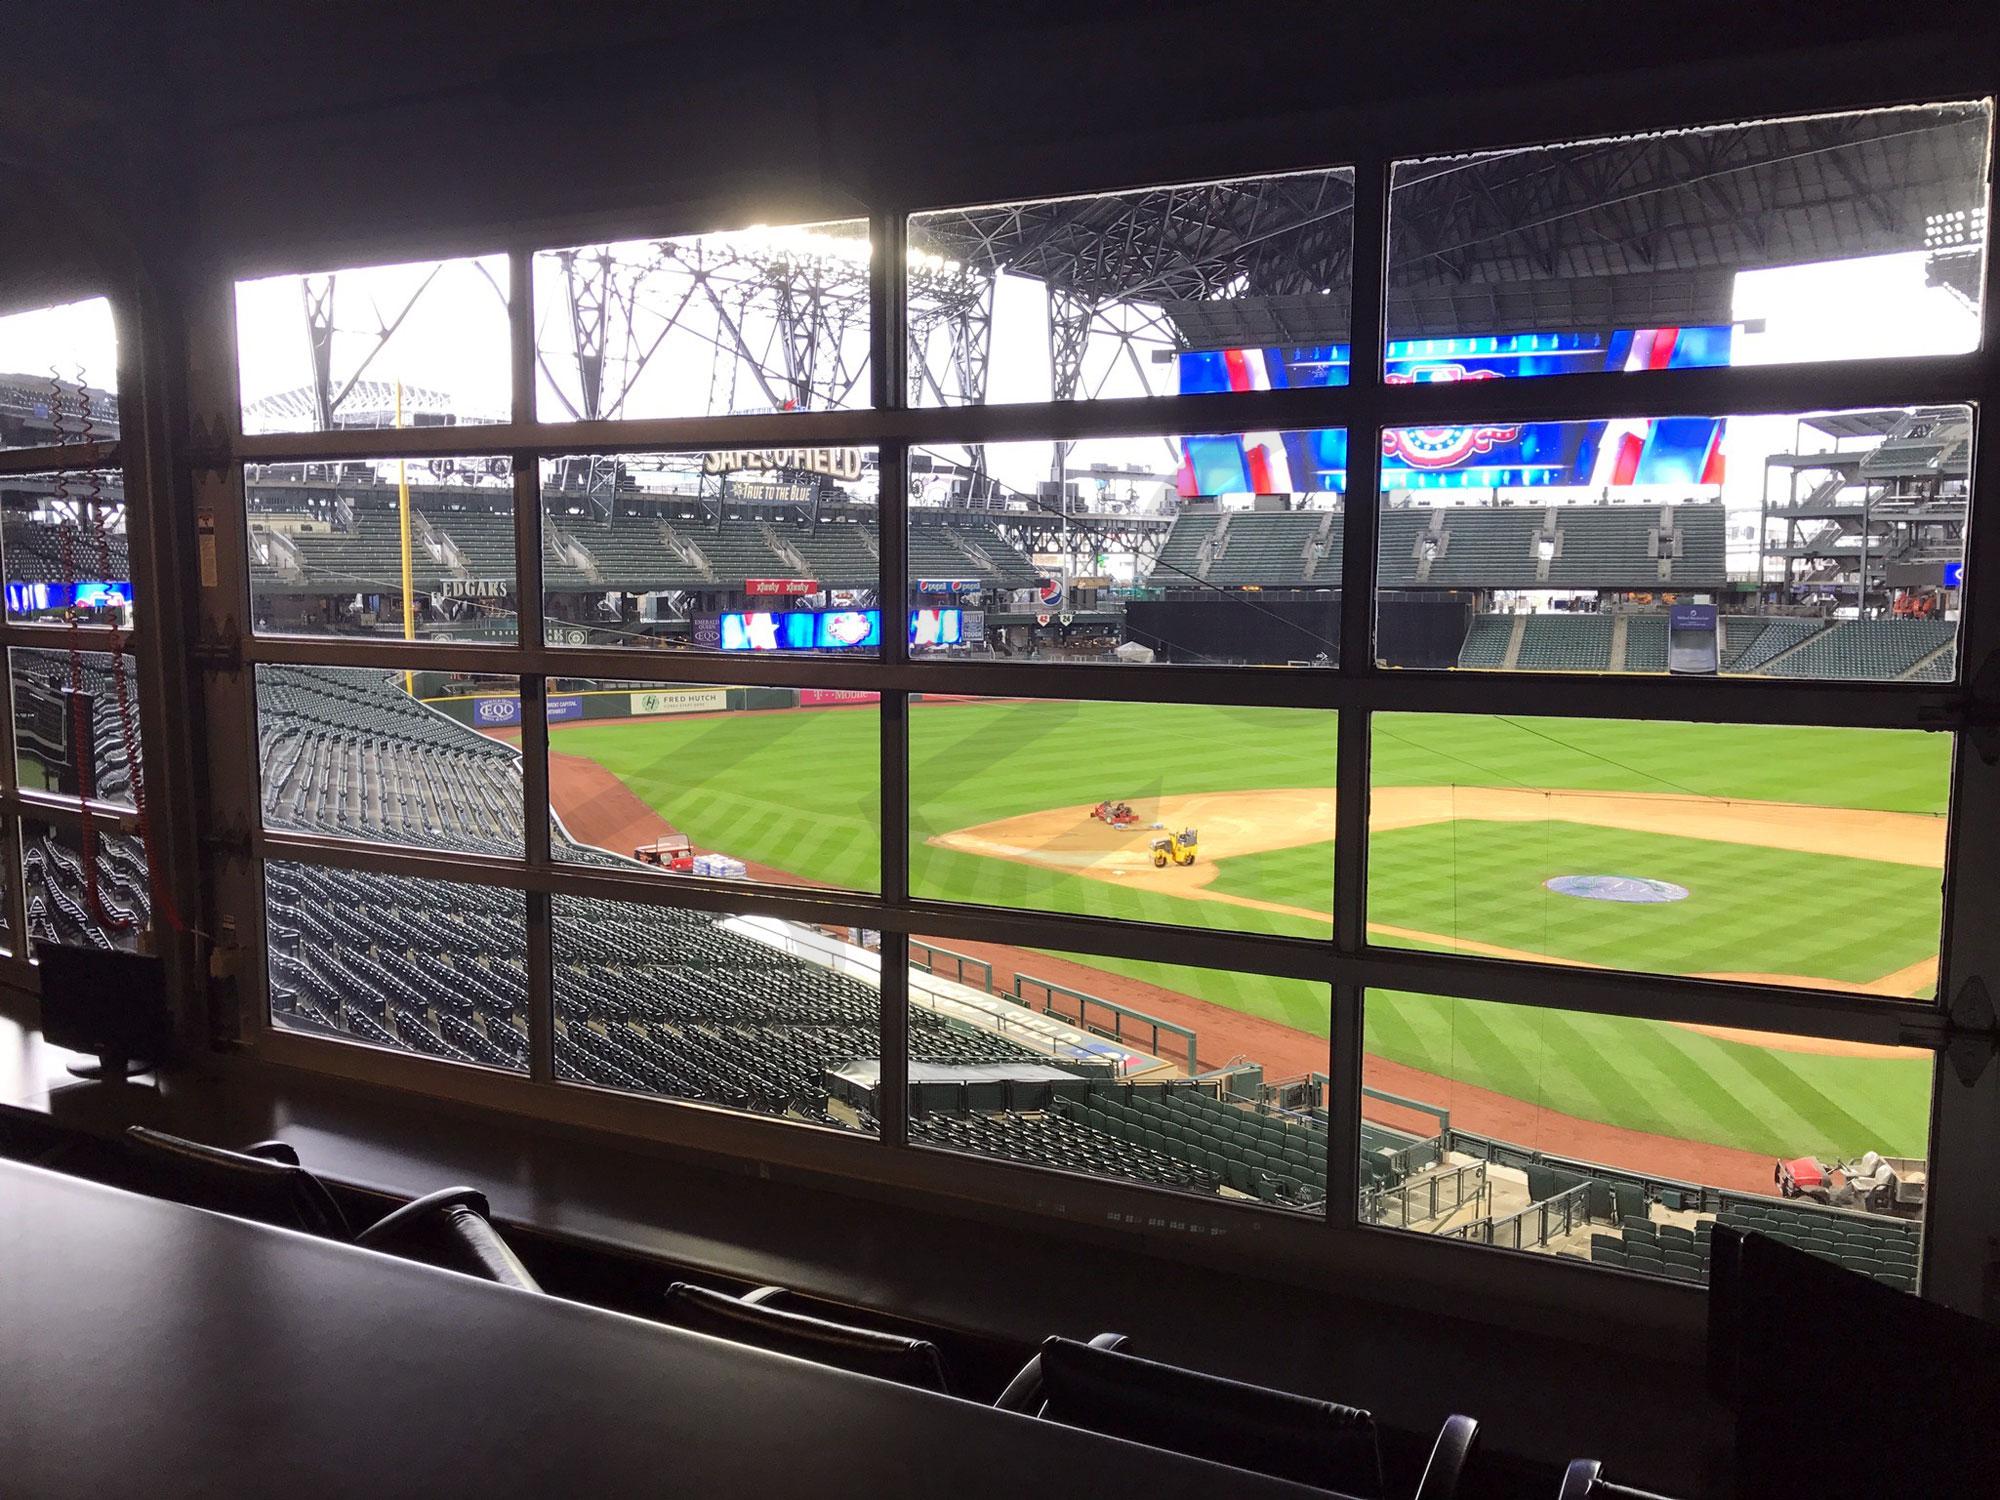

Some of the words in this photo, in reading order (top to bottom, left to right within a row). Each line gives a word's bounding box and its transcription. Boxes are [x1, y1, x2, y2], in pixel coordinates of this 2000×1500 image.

[792, 449, 863, 480] FIELD
[742, 482, 763, 500] TRUE
[765, 486, 774, 500] TO
[776, 486, 789, 501] THE
[790, 484, 811, 501] BLUE
[964, 613, 983, 623] BUILT
[1039, 615, 1048, 623] 42
[1062, 615, 1071, 623] 24
[663, 695, 686, 703] FRED
